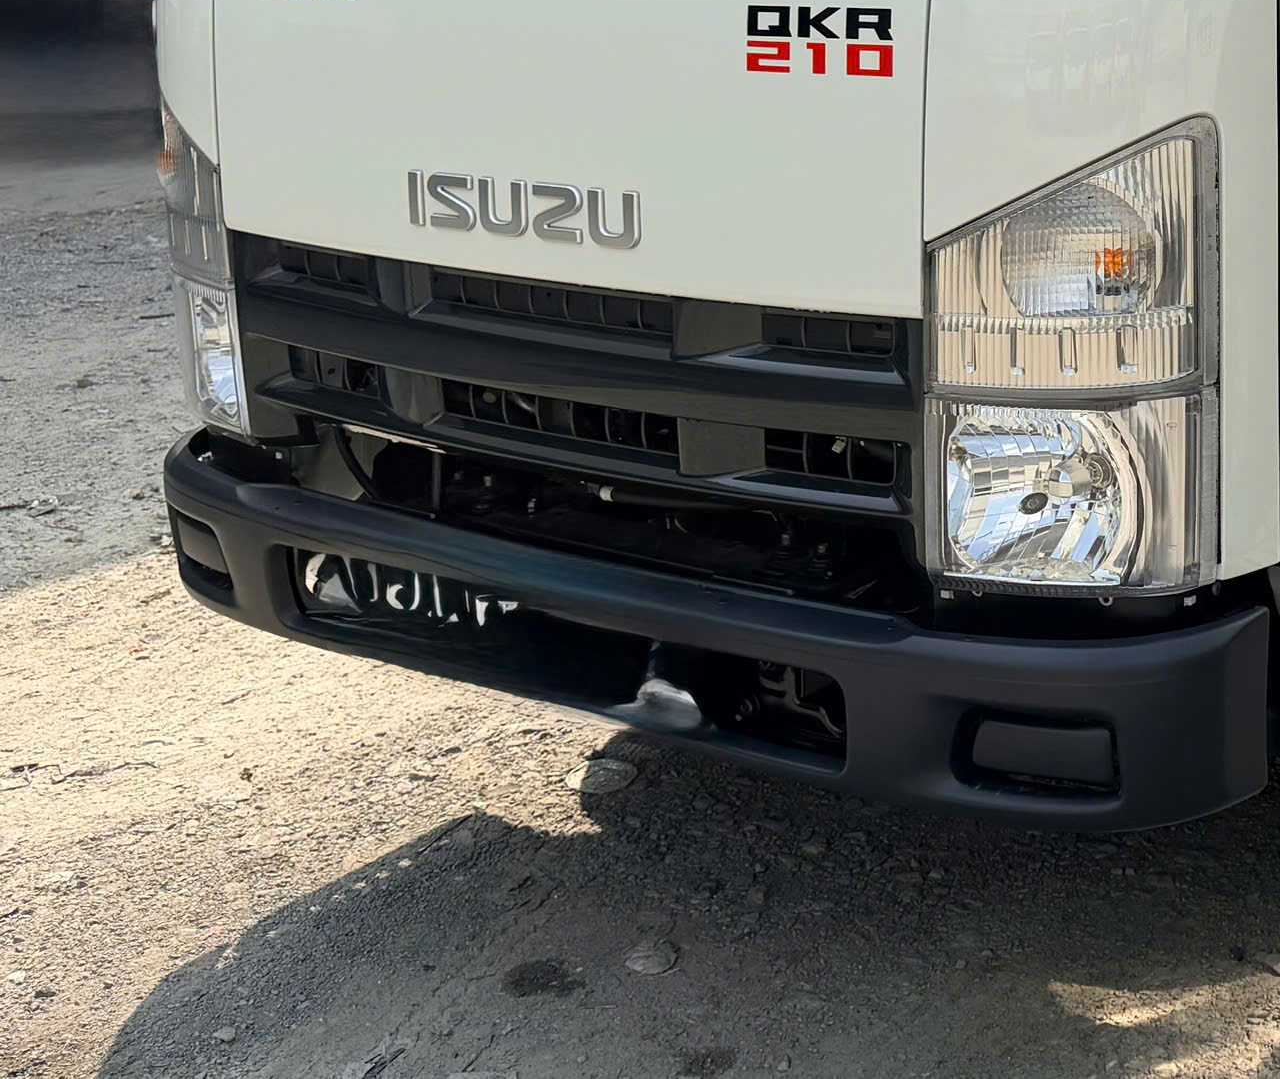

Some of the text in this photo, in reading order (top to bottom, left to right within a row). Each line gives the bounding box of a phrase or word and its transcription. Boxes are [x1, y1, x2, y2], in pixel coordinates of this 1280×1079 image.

[746, 4, 895, 42] QKR
[746, 39, 894, 78] 210
[407, 169, 642, 250] ISUZU
